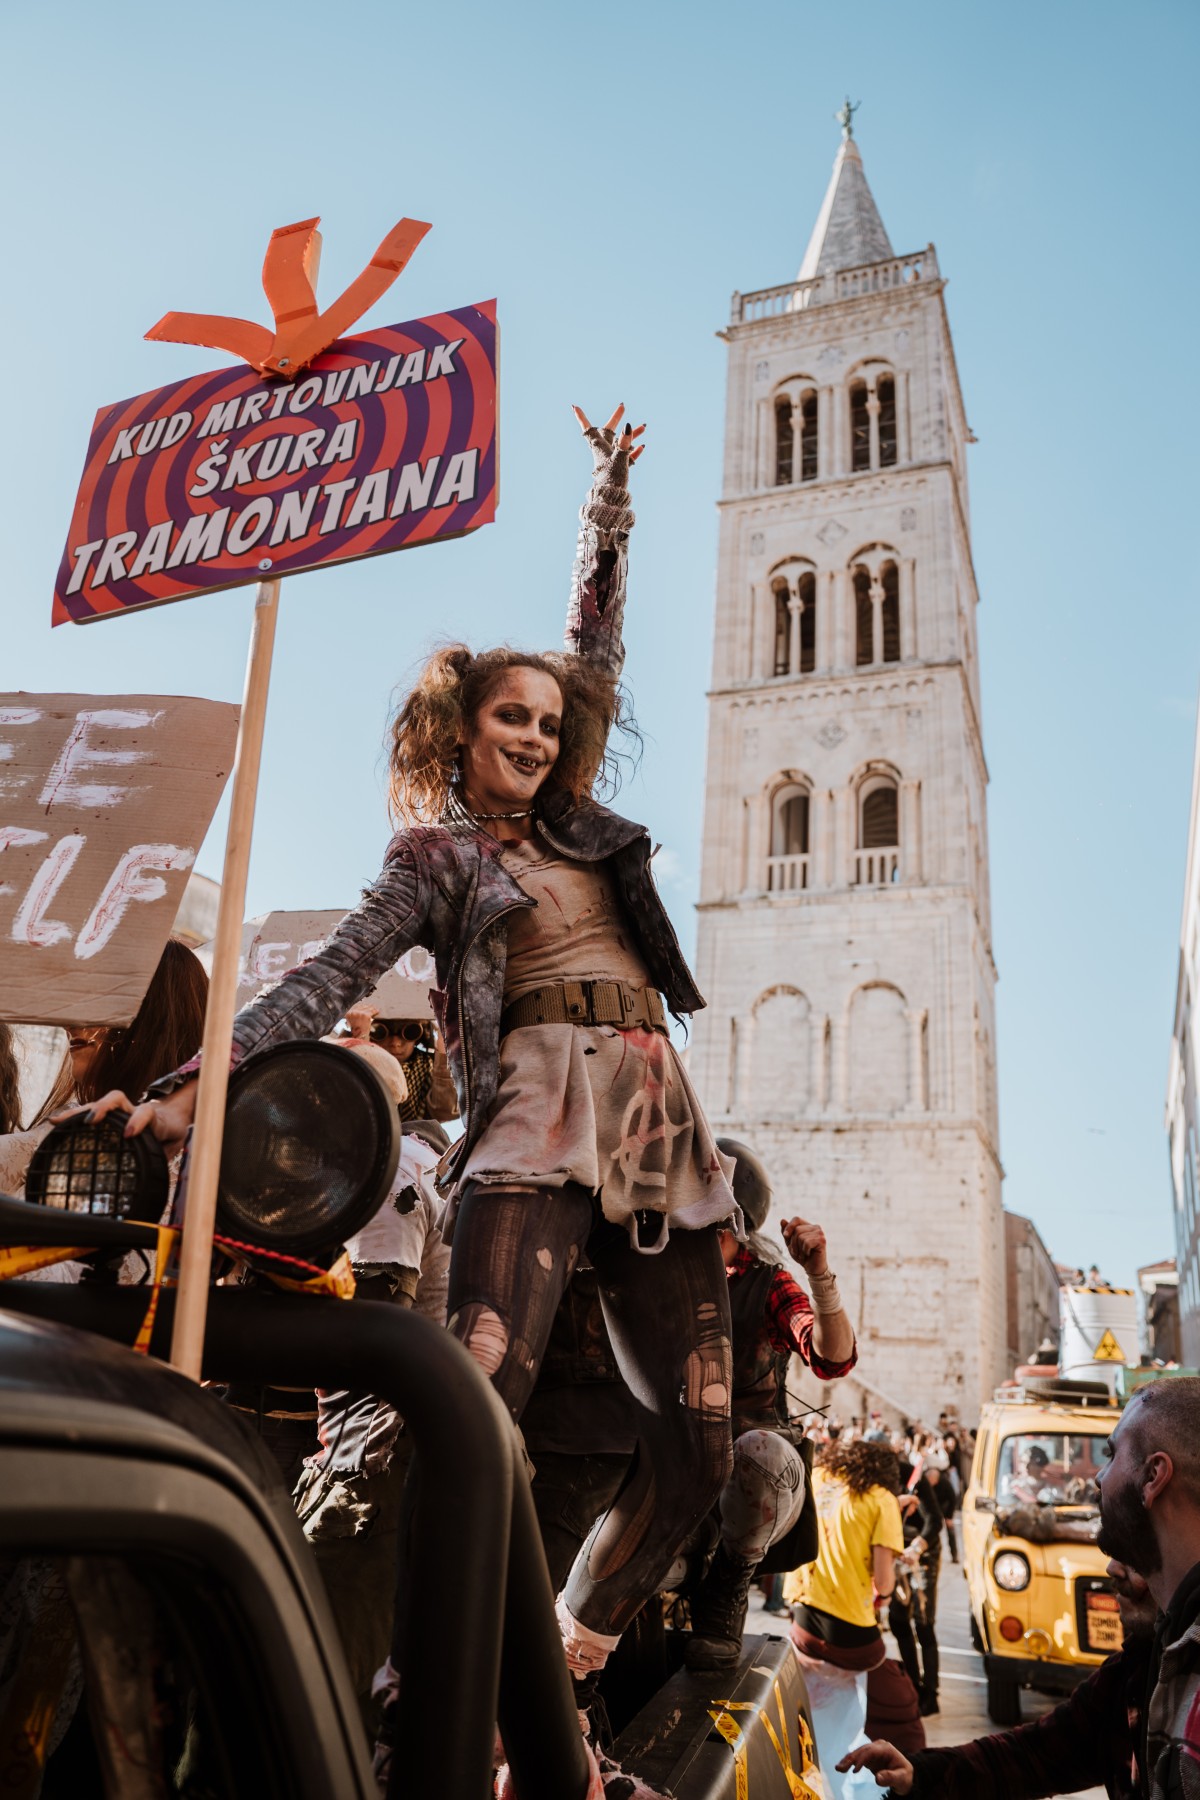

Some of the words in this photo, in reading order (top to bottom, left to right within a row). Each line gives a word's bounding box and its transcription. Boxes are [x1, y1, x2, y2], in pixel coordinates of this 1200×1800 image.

[107, 411, 194, 465] KUD
[197, 338, 467, 439] MRTOVNJAK
[189, 419, 360, 497] ŠKURA
[65, 448, 480, 596] TRAMONTANA
[1096, 1630, 1115, 1642] ZONE
